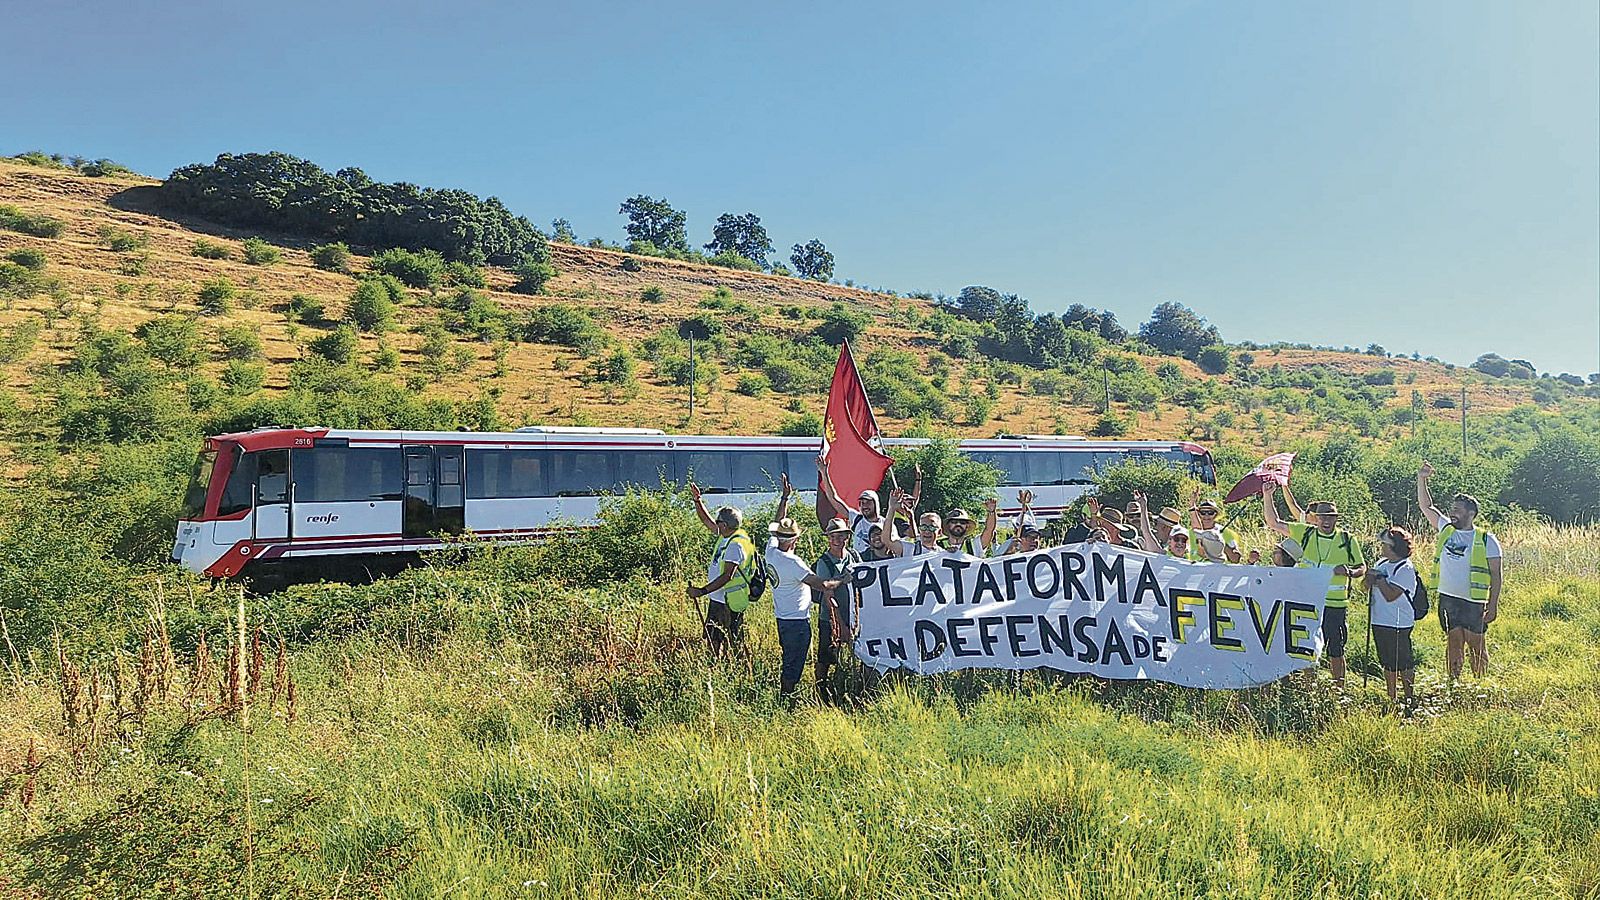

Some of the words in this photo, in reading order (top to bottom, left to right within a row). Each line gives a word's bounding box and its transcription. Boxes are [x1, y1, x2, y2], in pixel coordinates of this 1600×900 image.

[307, 512, 339, 525] renfe
[852, 552, 1168, 608] PLATAFORMA
[866, 637, 908, 661] EN
[914, 615, 1134, 666] DEFENSA
[1133, 635, 1167, 662] DE
[1168, 587, 1319, 662] FEVE
